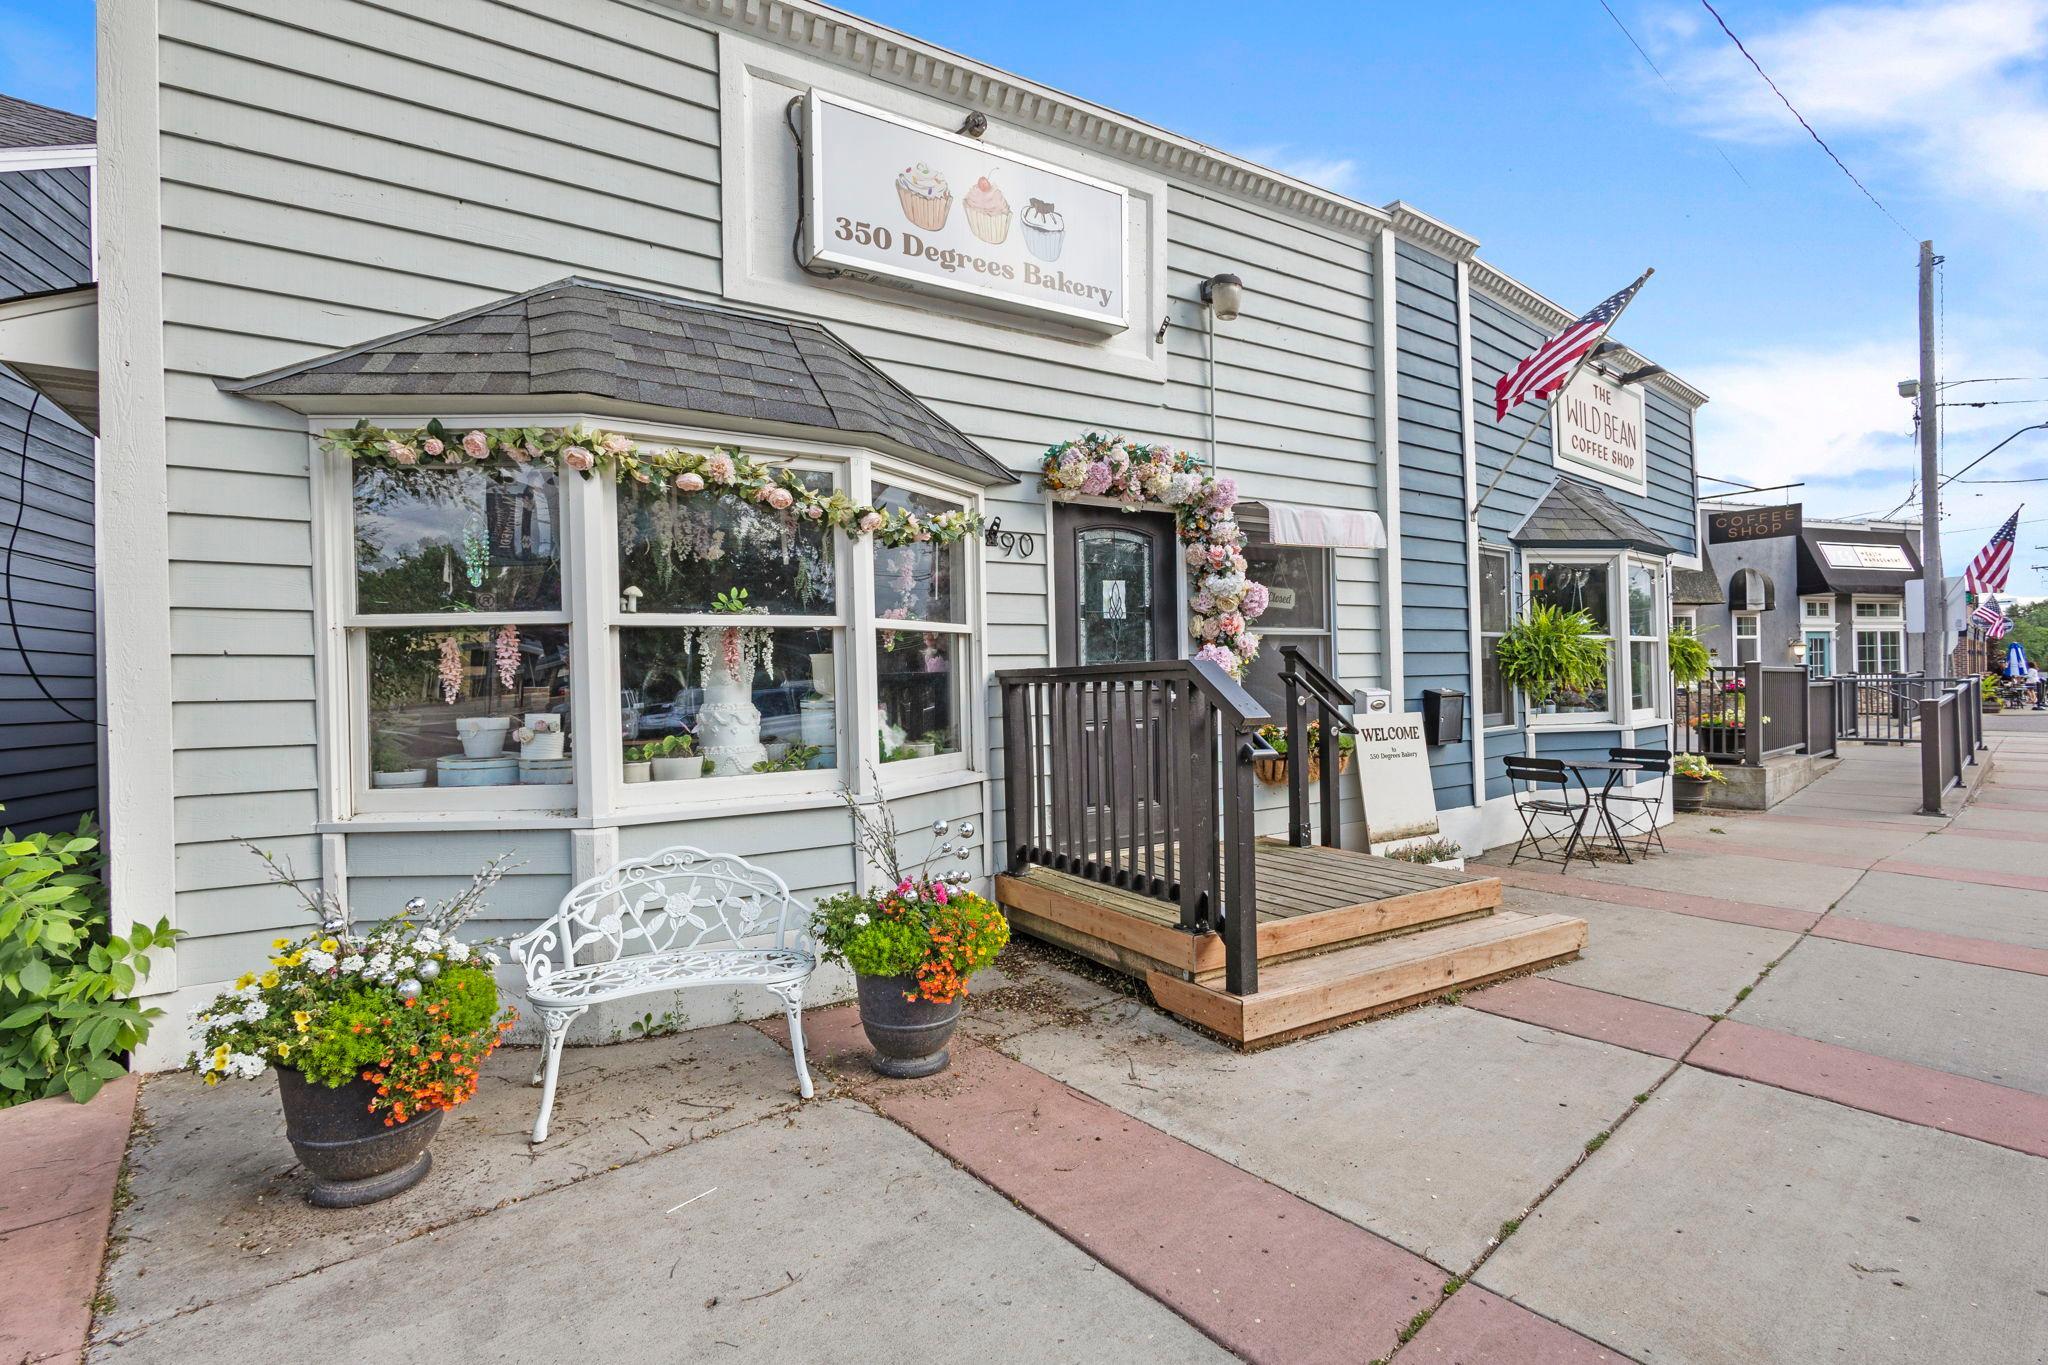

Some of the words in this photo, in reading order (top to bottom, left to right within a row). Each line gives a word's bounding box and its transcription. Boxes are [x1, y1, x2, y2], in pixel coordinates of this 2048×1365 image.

[835, 216, 893, 250] 350
[902, 233, 1015, 280] Degrees
[1023, 262, 1113, 307] Bakery
[1593, 384, 1612, 405] THE
[1566, 395, 1600, 435] WILD
[1604, 412, 1637, 451] BEAN
[1571, 435, 1608, 461] COFFEE
[1611, 450, 1635, 470] SHOP
[1715, 509, 1796, 528] COFFEE
[1727, 523, 1783, 538] SHOP
[1000, 532, 1034, 558] 90
[1269, 592, 1292, 604] Closed
[1361, 727, 1420, 741] WELCOME
[1380, 753, 1401, 761] Degrees
